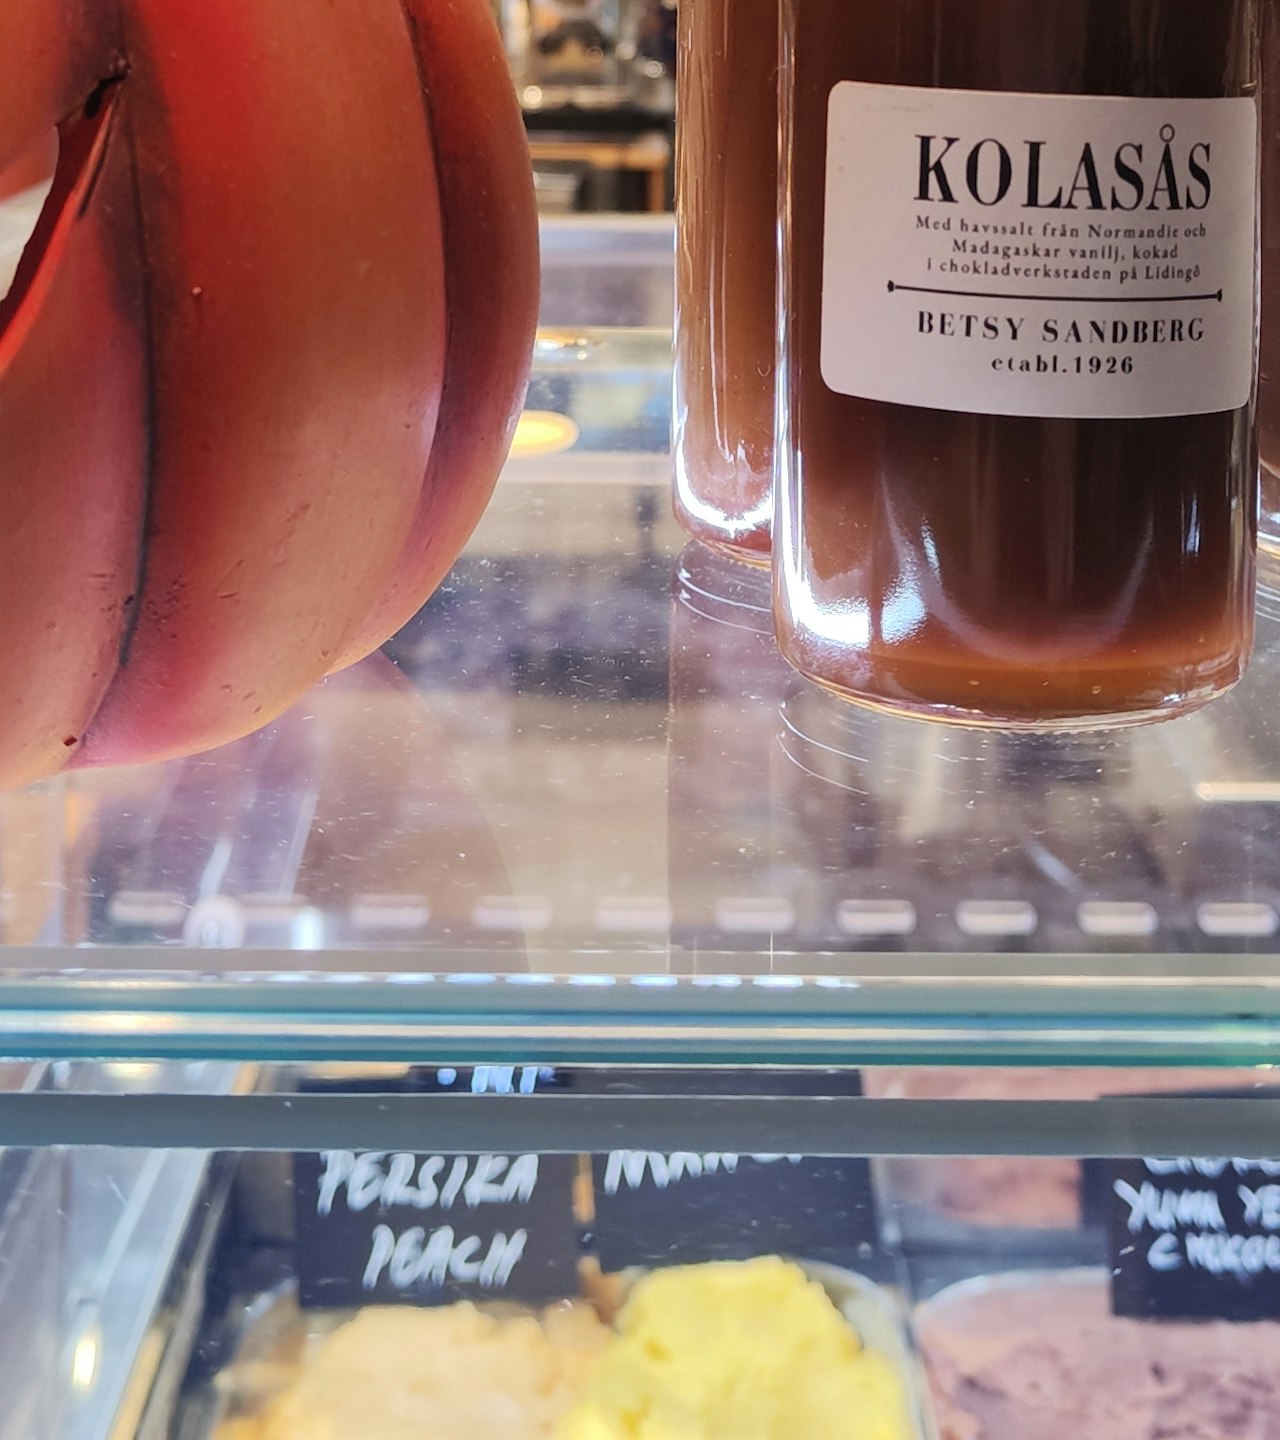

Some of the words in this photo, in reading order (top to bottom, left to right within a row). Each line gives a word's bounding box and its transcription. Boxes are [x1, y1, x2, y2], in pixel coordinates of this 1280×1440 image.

[913, 124, 1211, 211] KOLASÅS
[916, 216, 951, 231] Med
[960, 219, 1033, 235] havssalt
[1042, 222, 1079, 238] från
[1088, 224, 1178, 239] Normandie
[1184, 223, 1206, 238] och
[952, 238, 1060, 259] Madagaskar
[1069, 243, 1125, 263] vanilj,
[1133, 243, 1178, 259] kokad
[927, 258, 932, 271] i
[940, 259, 1111, 280] chokladverkstaden
[1119, 264, 1137, 284] på
[1144, 265, 1200, 282] Lidingö
[918, 311, 1024, 341] BETSY
[1042, 317, 1204, 344] SANDBERG
[991, 355, 1133, 374] etabl.1926
[362, 1224, 527, 1290] PEACH
